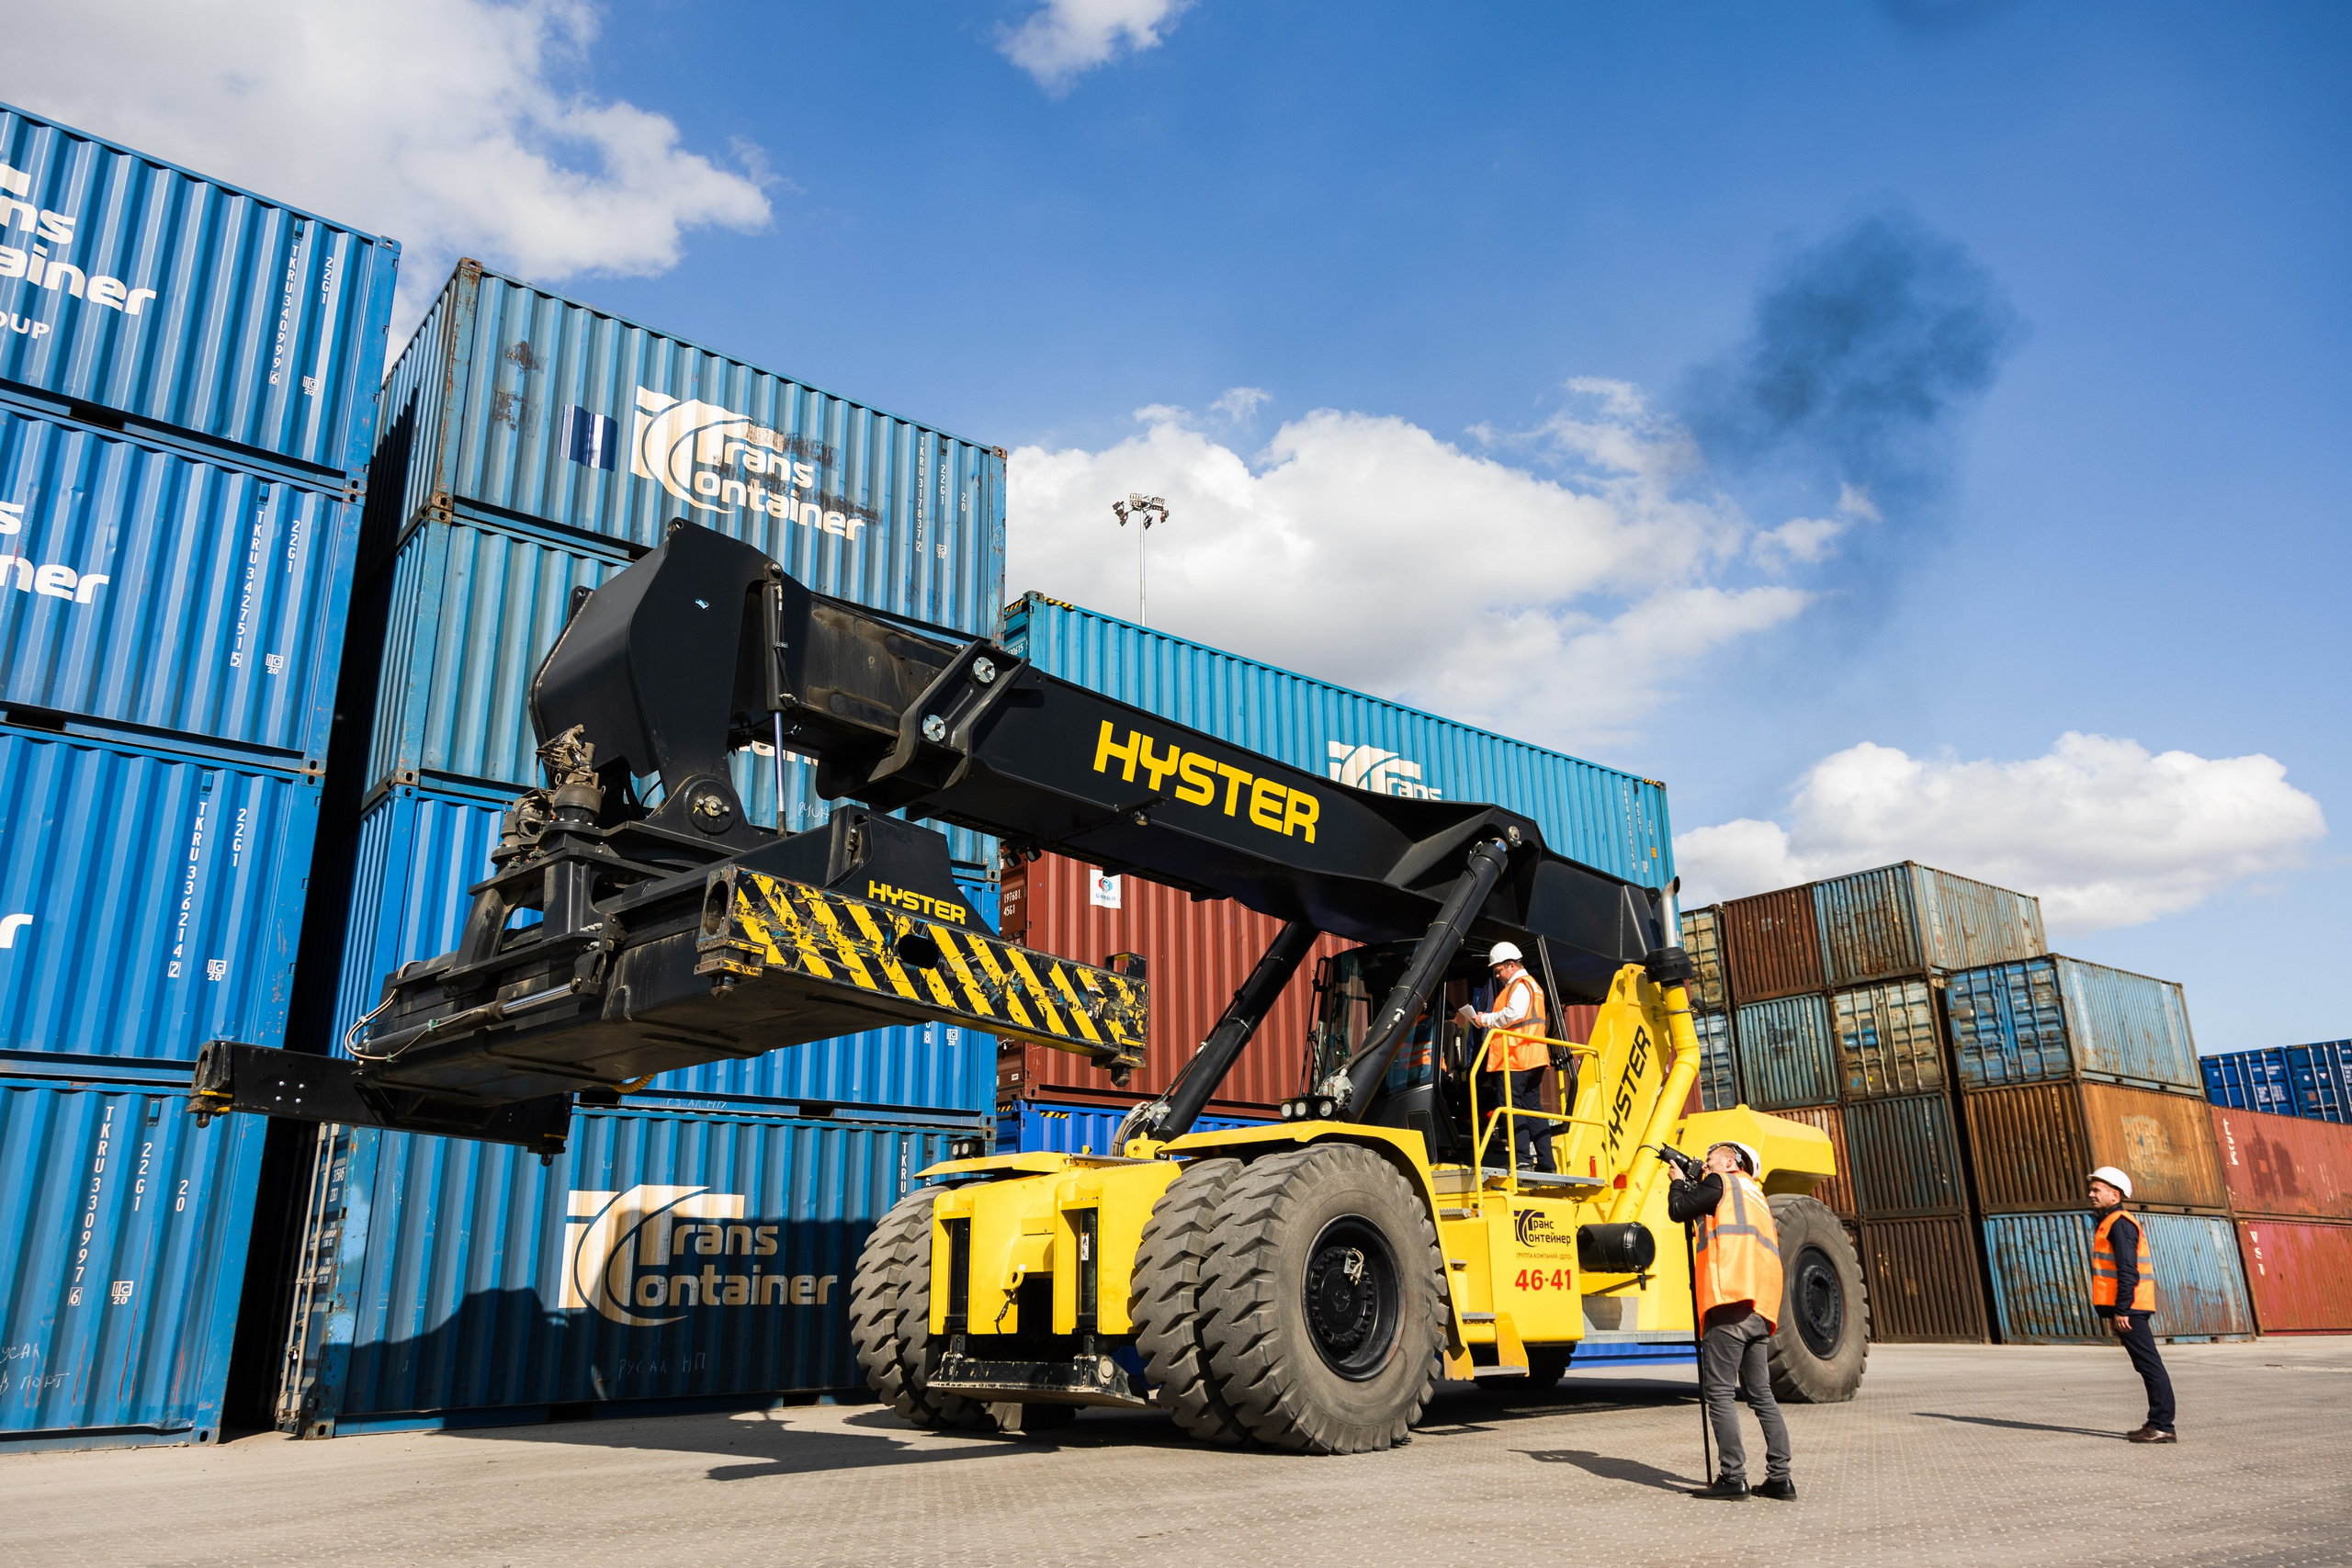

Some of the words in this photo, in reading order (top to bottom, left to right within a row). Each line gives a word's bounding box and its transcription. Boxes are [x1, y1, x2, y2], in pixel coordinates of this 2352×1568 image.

[321, 256, 334, 304] 22G1
[961, 492, 967, 512] 20
[287, 520, 301, 573] 22G1
[1093, 720, 1319, 843] HYSTER
[233, 807, 247, 867] 22G1
[868, 880, 967, 925] HYSTER
[134, 1142, 153, 1212] 22G1
[175, 1179, 189, 1213] 20
[113, 1296, 128, 1305] 20
